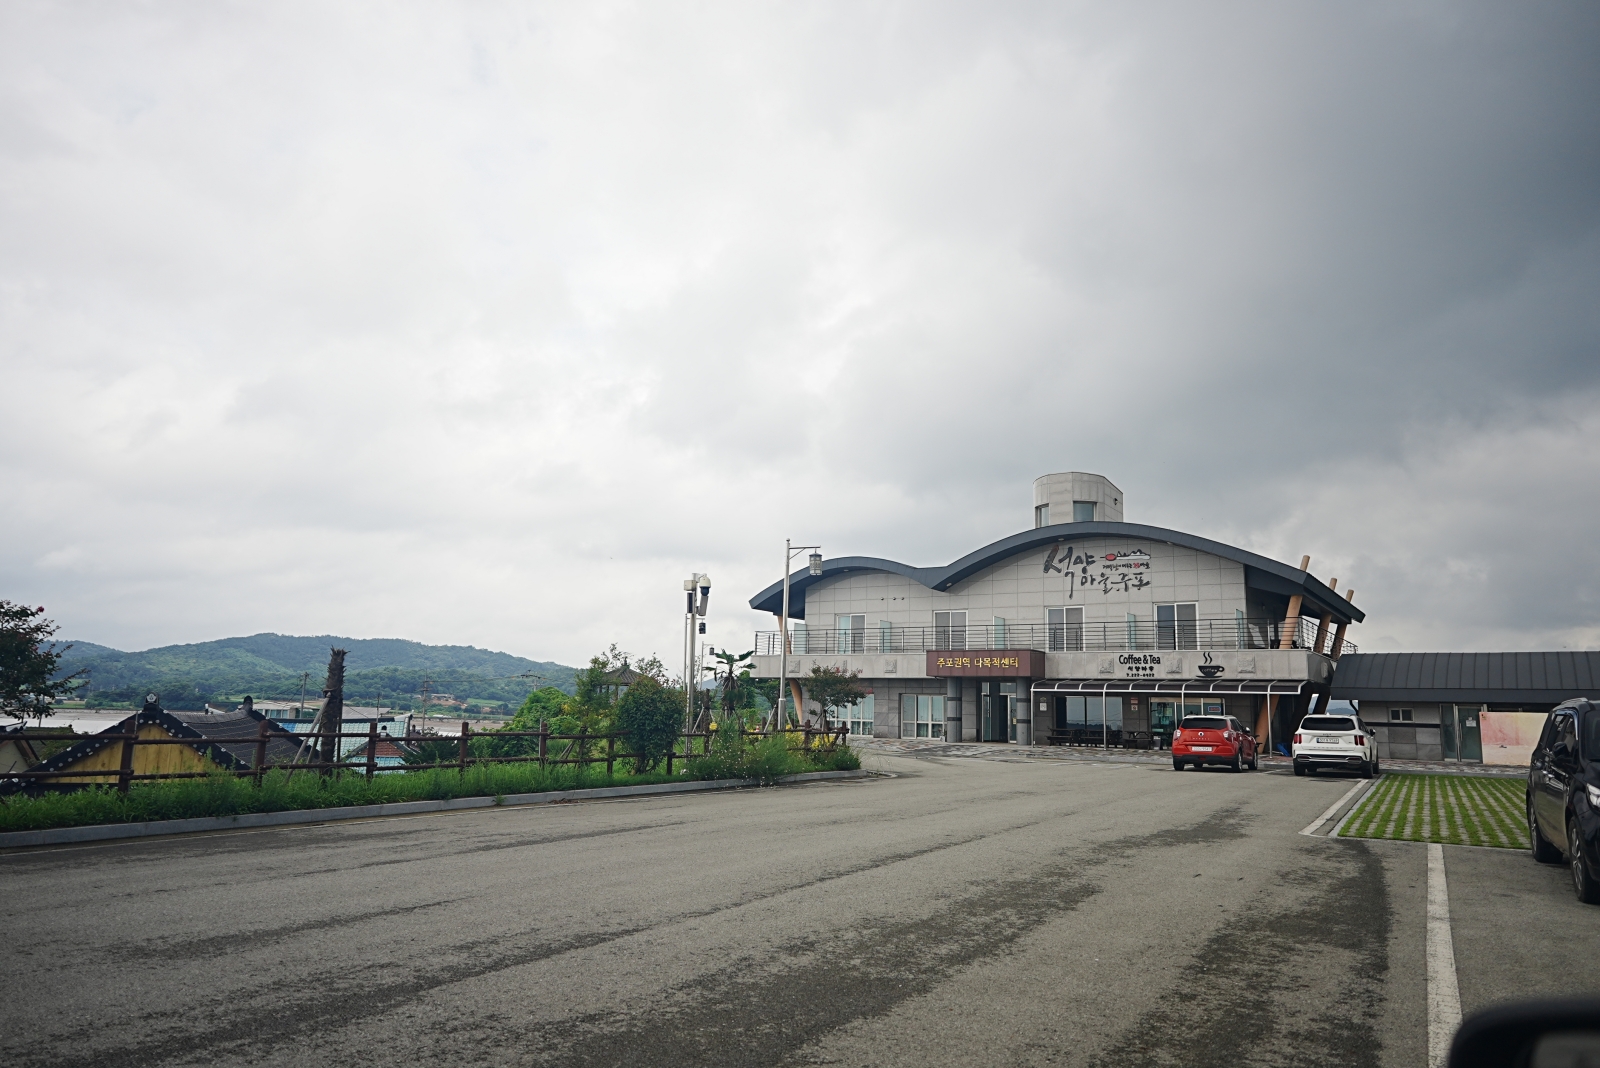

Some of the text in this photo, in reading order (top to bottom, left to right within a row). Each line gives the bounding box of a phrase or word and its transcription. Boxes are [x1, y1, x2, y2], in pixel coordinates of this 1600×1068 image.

[1043, 545, 1096, 600] 석양
[936, 657, 1019, 669] 주포권역 다목적센터
[1118, 654, 1142, 665] Coffee
